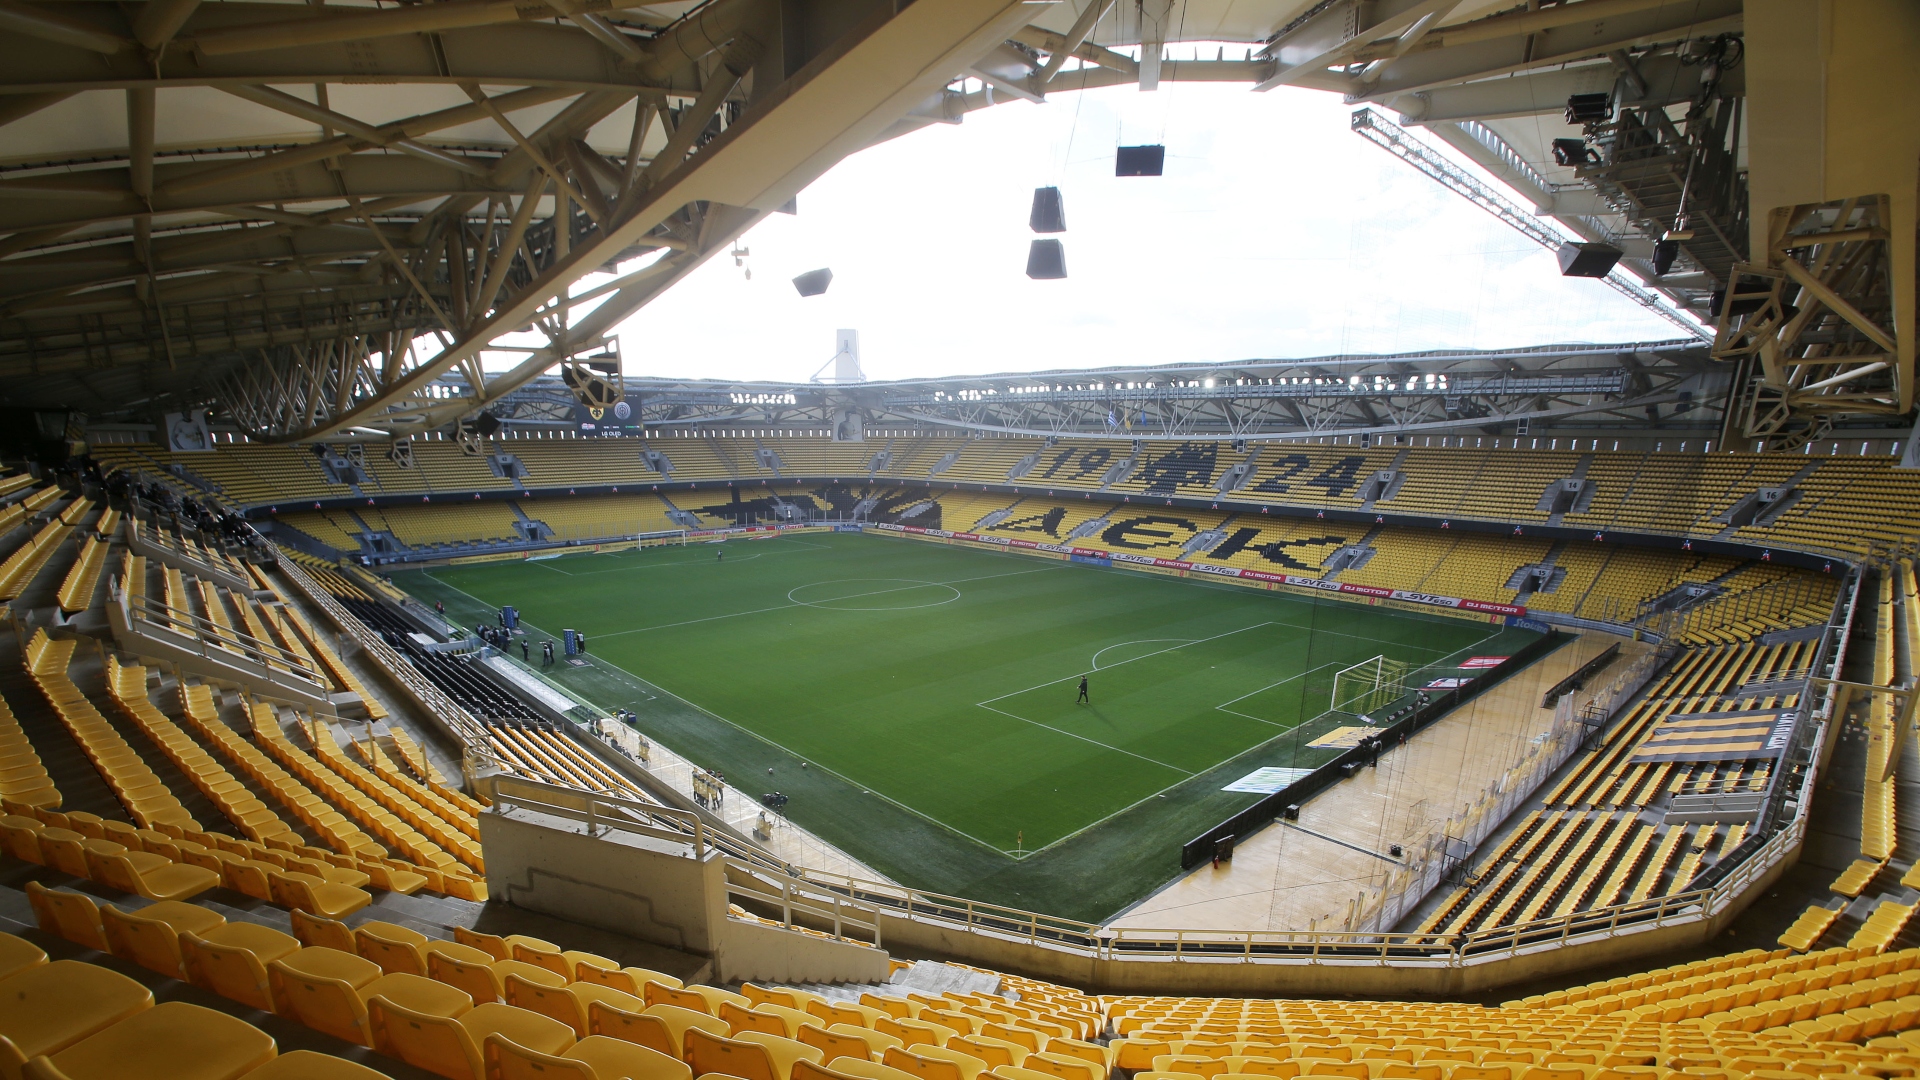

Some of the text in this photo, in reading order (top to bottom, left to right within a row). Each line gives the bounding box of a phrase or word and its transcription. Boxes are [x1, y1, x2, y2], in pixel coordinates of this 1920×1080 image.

[1043, 448, 1111, 480] 19
[1253, 454, 1367, 497] 24
[1122, 555, 1152, 563] SVT650
[1201, 566, 1235, 575] SVT650
[1297, 579, 1337, 589] SVT650
[1356, 587, 1389, 595] MOTOR
[1405, 594, 1452, 605] SVT650
[1480, 604, 1517, 613] MOTOR
